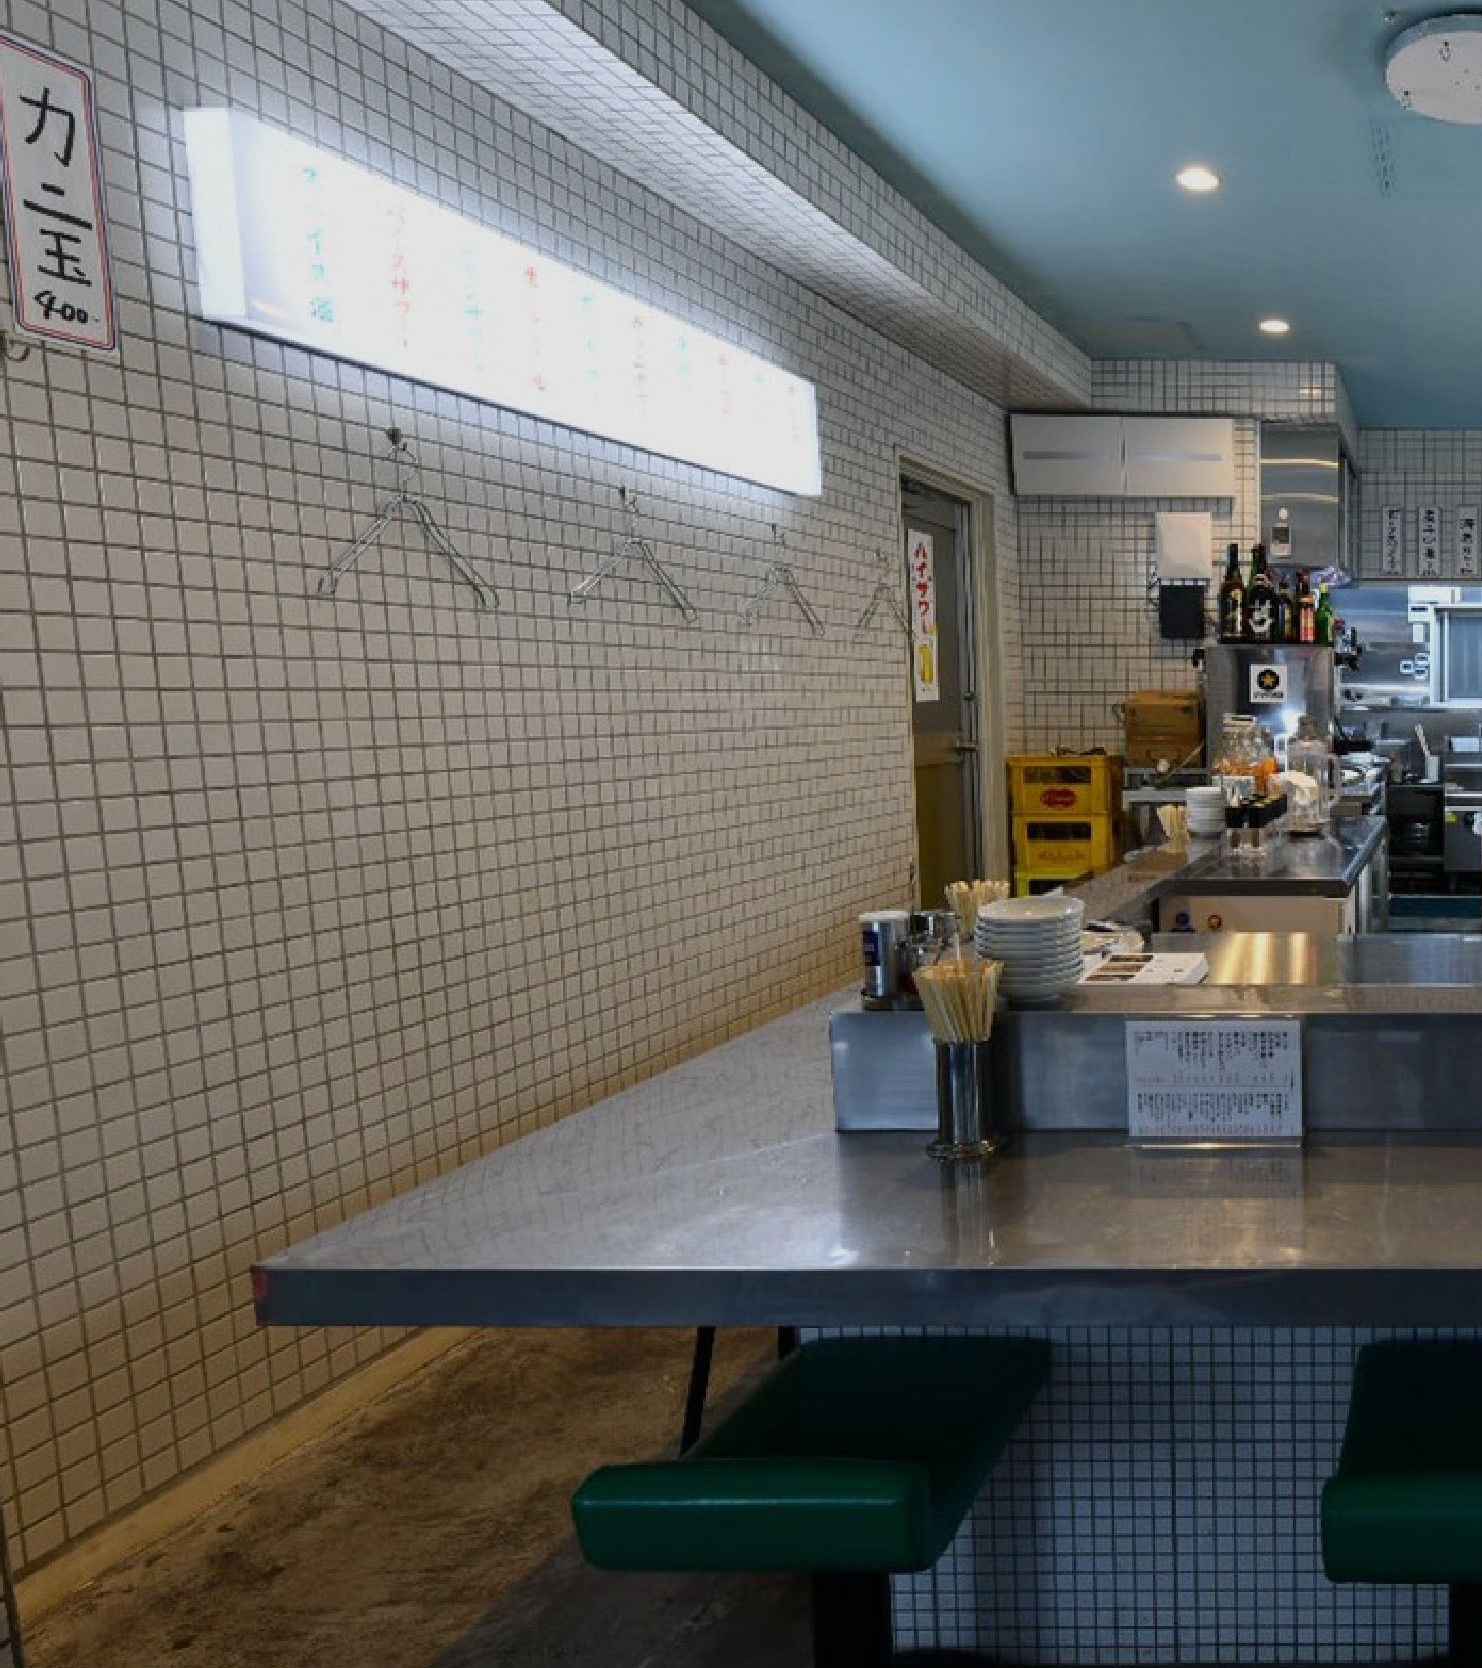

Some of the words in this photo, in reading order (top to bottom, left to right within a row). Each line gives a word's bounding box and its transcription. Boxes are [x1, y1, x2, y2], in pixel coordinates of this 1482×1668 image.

[19, 86, 93, 288] カニ玉
[913, 541, 930, 635] ハイサワー
